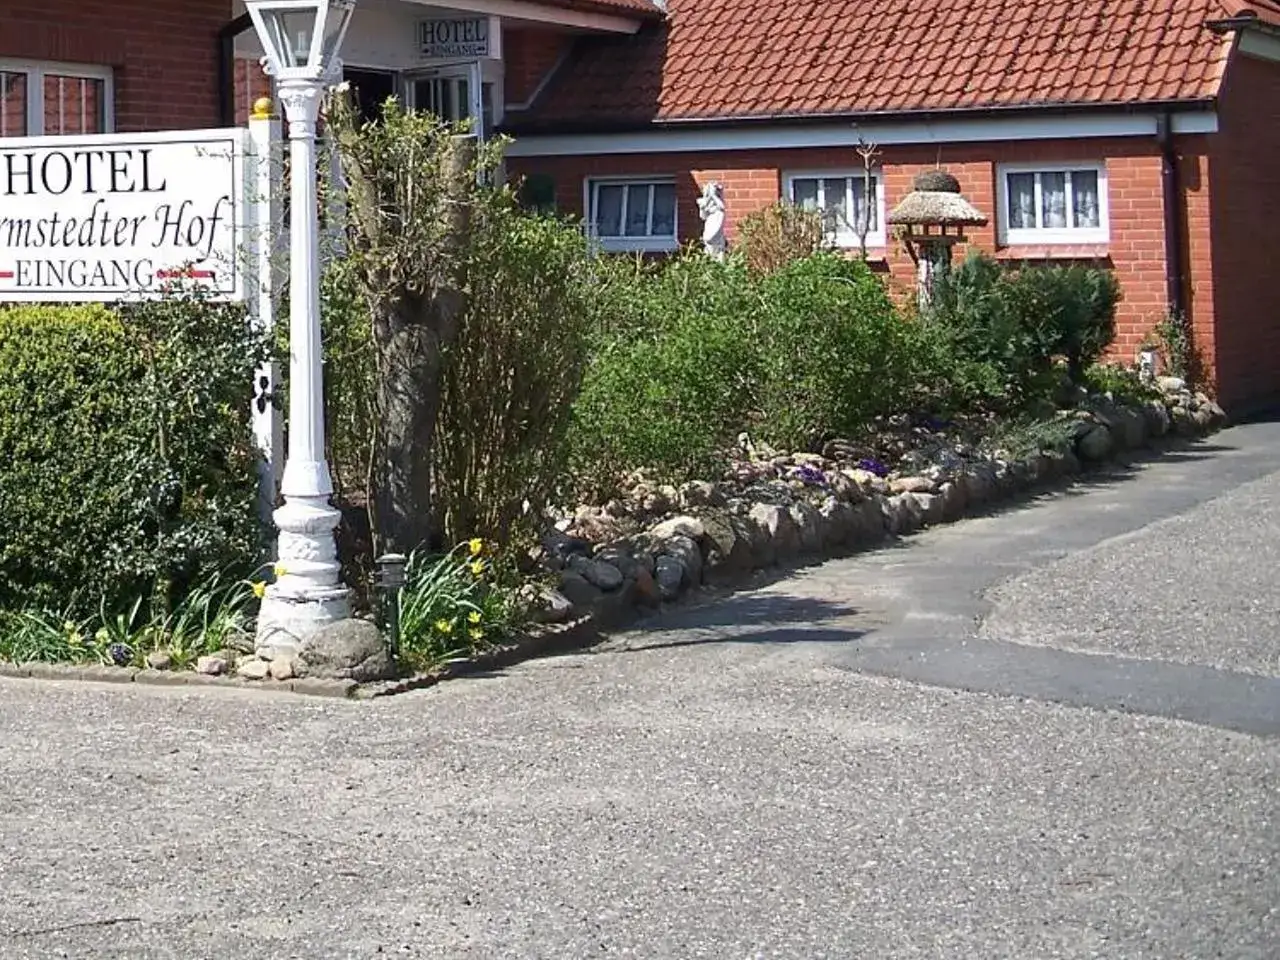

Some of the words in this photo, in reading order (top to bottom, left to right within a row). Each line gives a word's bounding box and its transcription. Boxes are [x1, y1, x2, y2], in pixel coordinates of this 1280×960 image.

[422, 19, 486, 44] HOTEL
[3, 148, 167, 196] HOTEL
[151, 195, 230, 264] Hof
[15, 258, 153, 288] EINGANG
